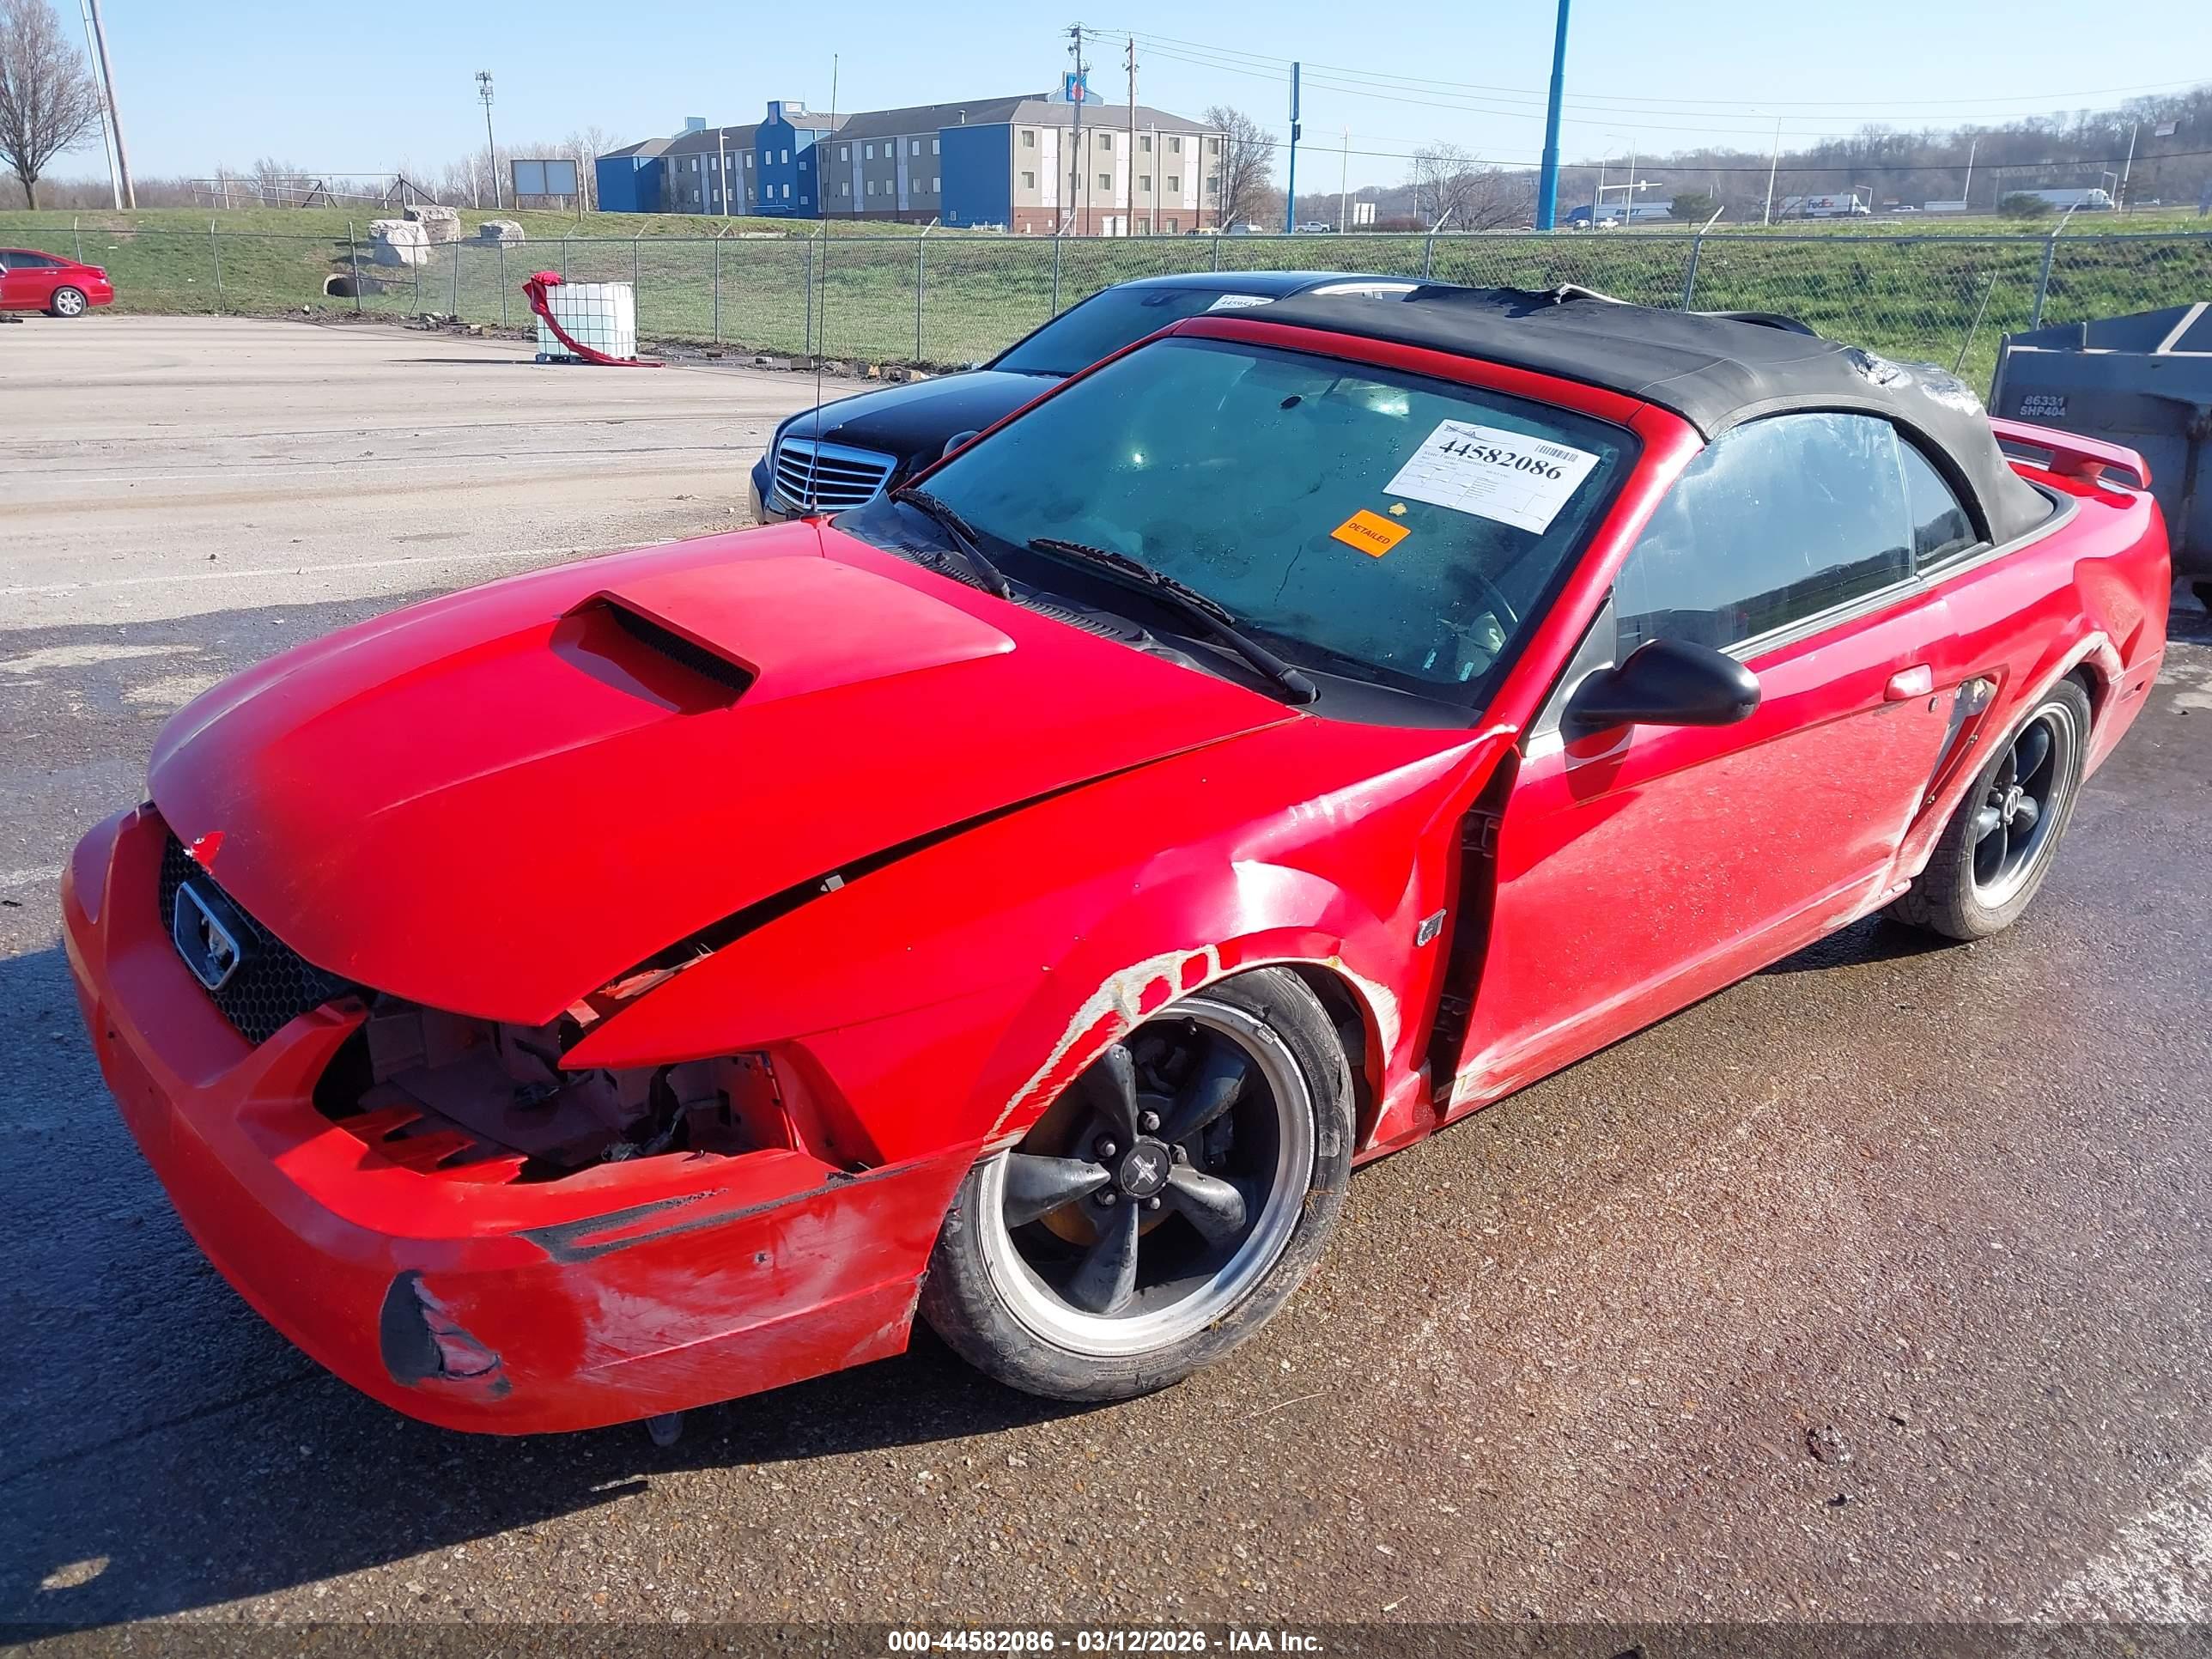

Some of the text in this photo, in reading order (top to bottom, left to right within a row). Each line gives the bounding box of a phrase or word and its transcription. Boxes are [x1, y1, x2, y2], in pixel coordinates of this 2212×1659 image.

[1808, 198, 1834, 209] FedEx
[2024, 395, 2064, 406] 86331
[2019, 405, 2066, 416] SHP404
[1438, 437, 1567, 480] 44582086
[1347, 522, 1391, 544] DETAILED
